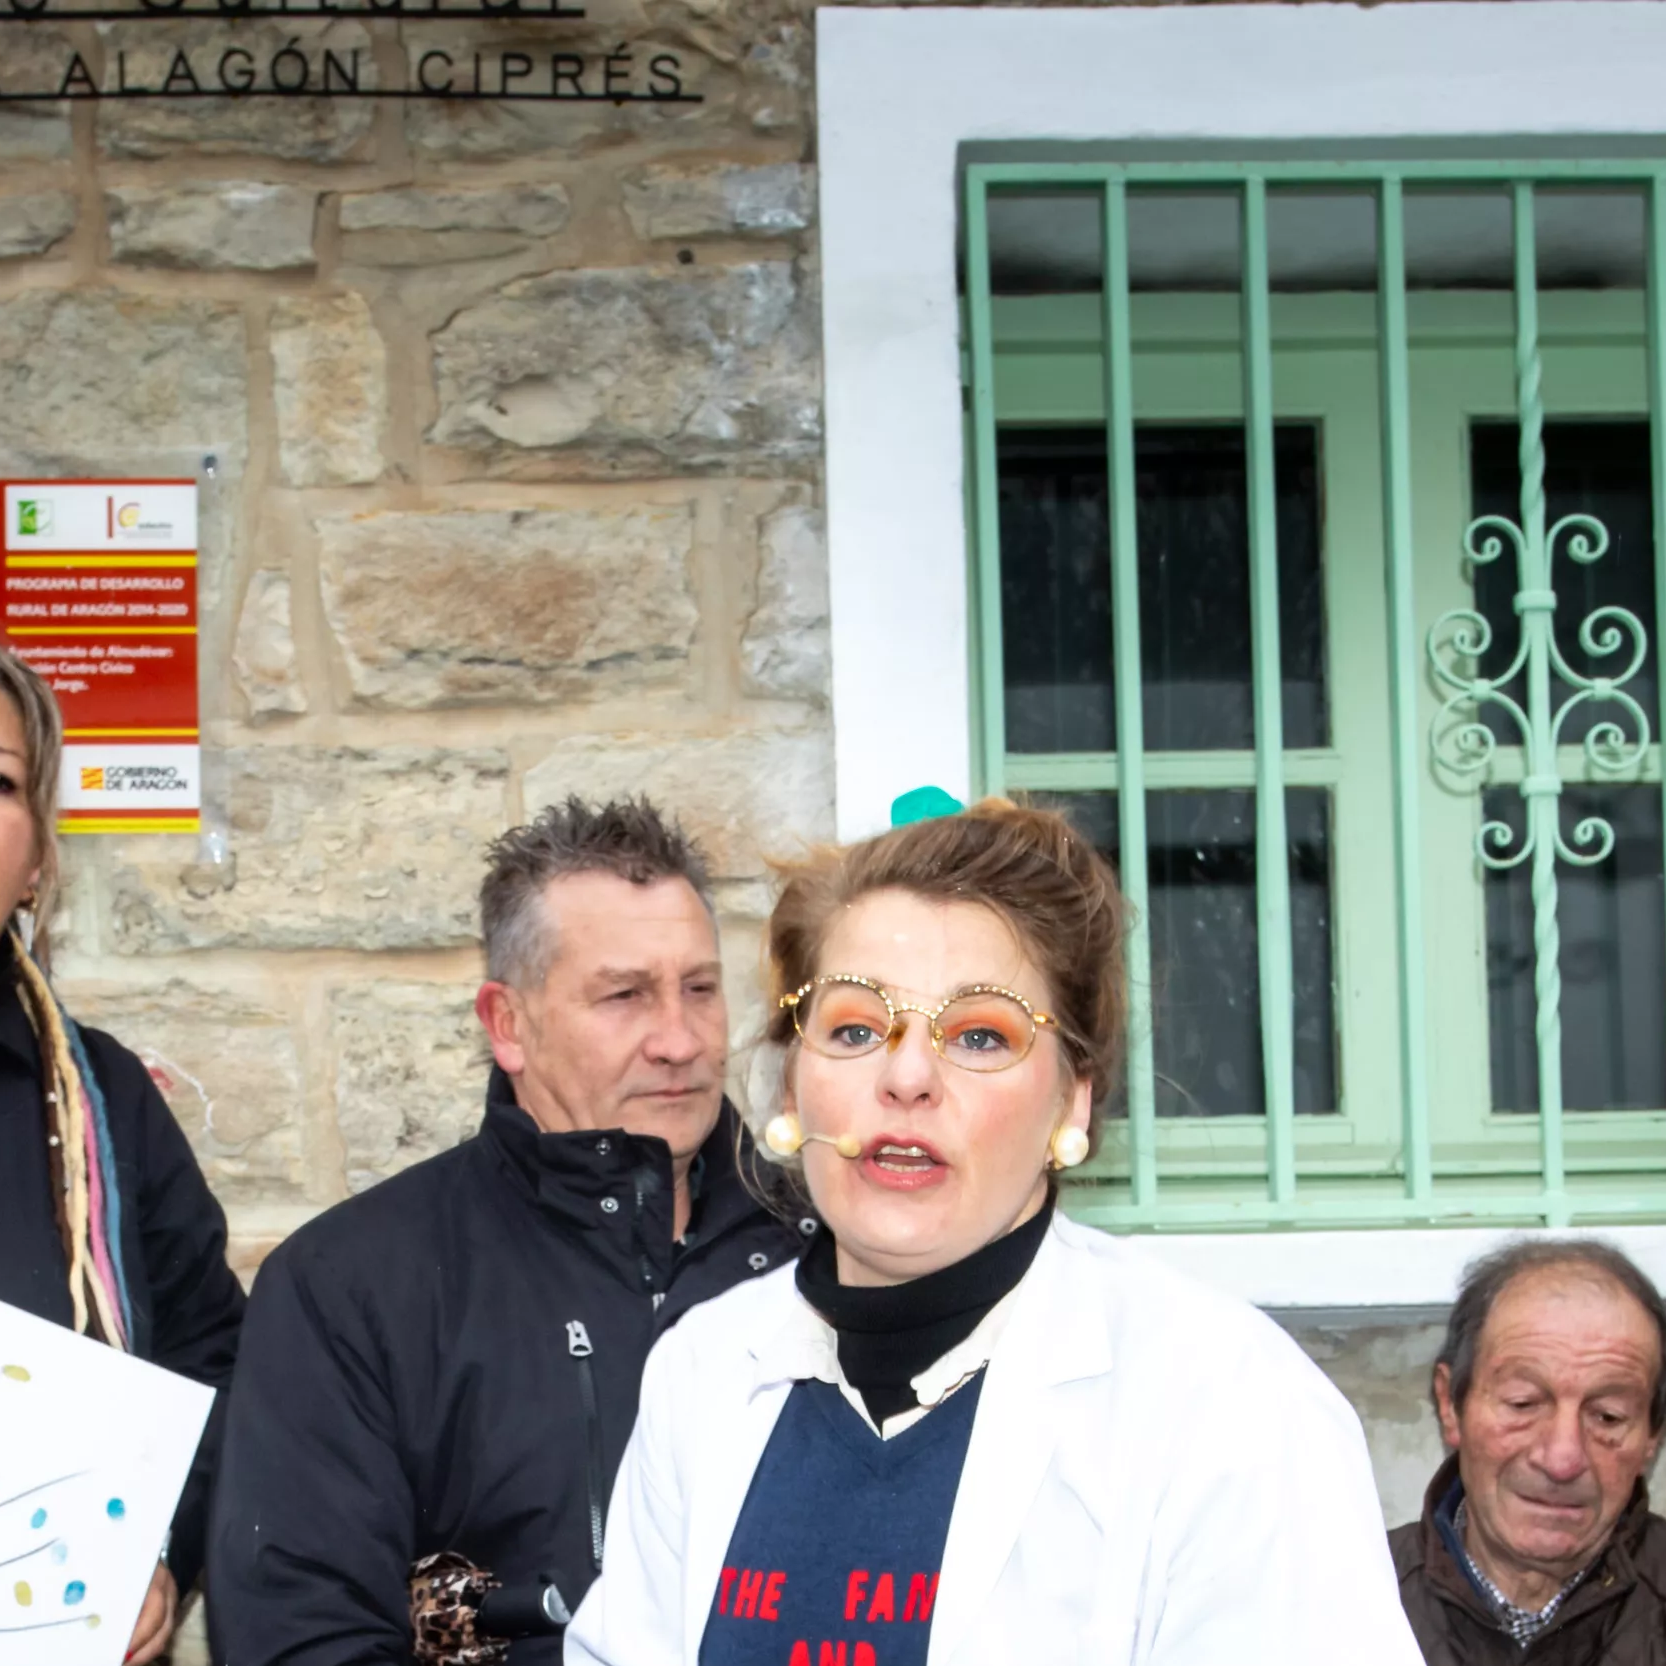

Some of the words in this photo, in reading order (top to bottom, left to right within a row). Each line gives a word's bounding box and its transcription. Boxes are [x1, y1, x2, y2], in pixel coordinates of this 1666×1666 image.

[58, 36, 359, 99] ALAGÓN
[417, 41, 683, 98] CIPRÉS
[6, 577, 77, 590] PROGRAMA
[79, 577, 98, 590] DE
[99, 577, 185, 590] DESARROLLO
[6, 604, 48, 616] RURAL
[50, 604, 69, 616] DE
[106, 766, 177, 778] GOBIERNO
[106, 779, 122, 790] DE
[719, 1567, 786, 1622] THE
